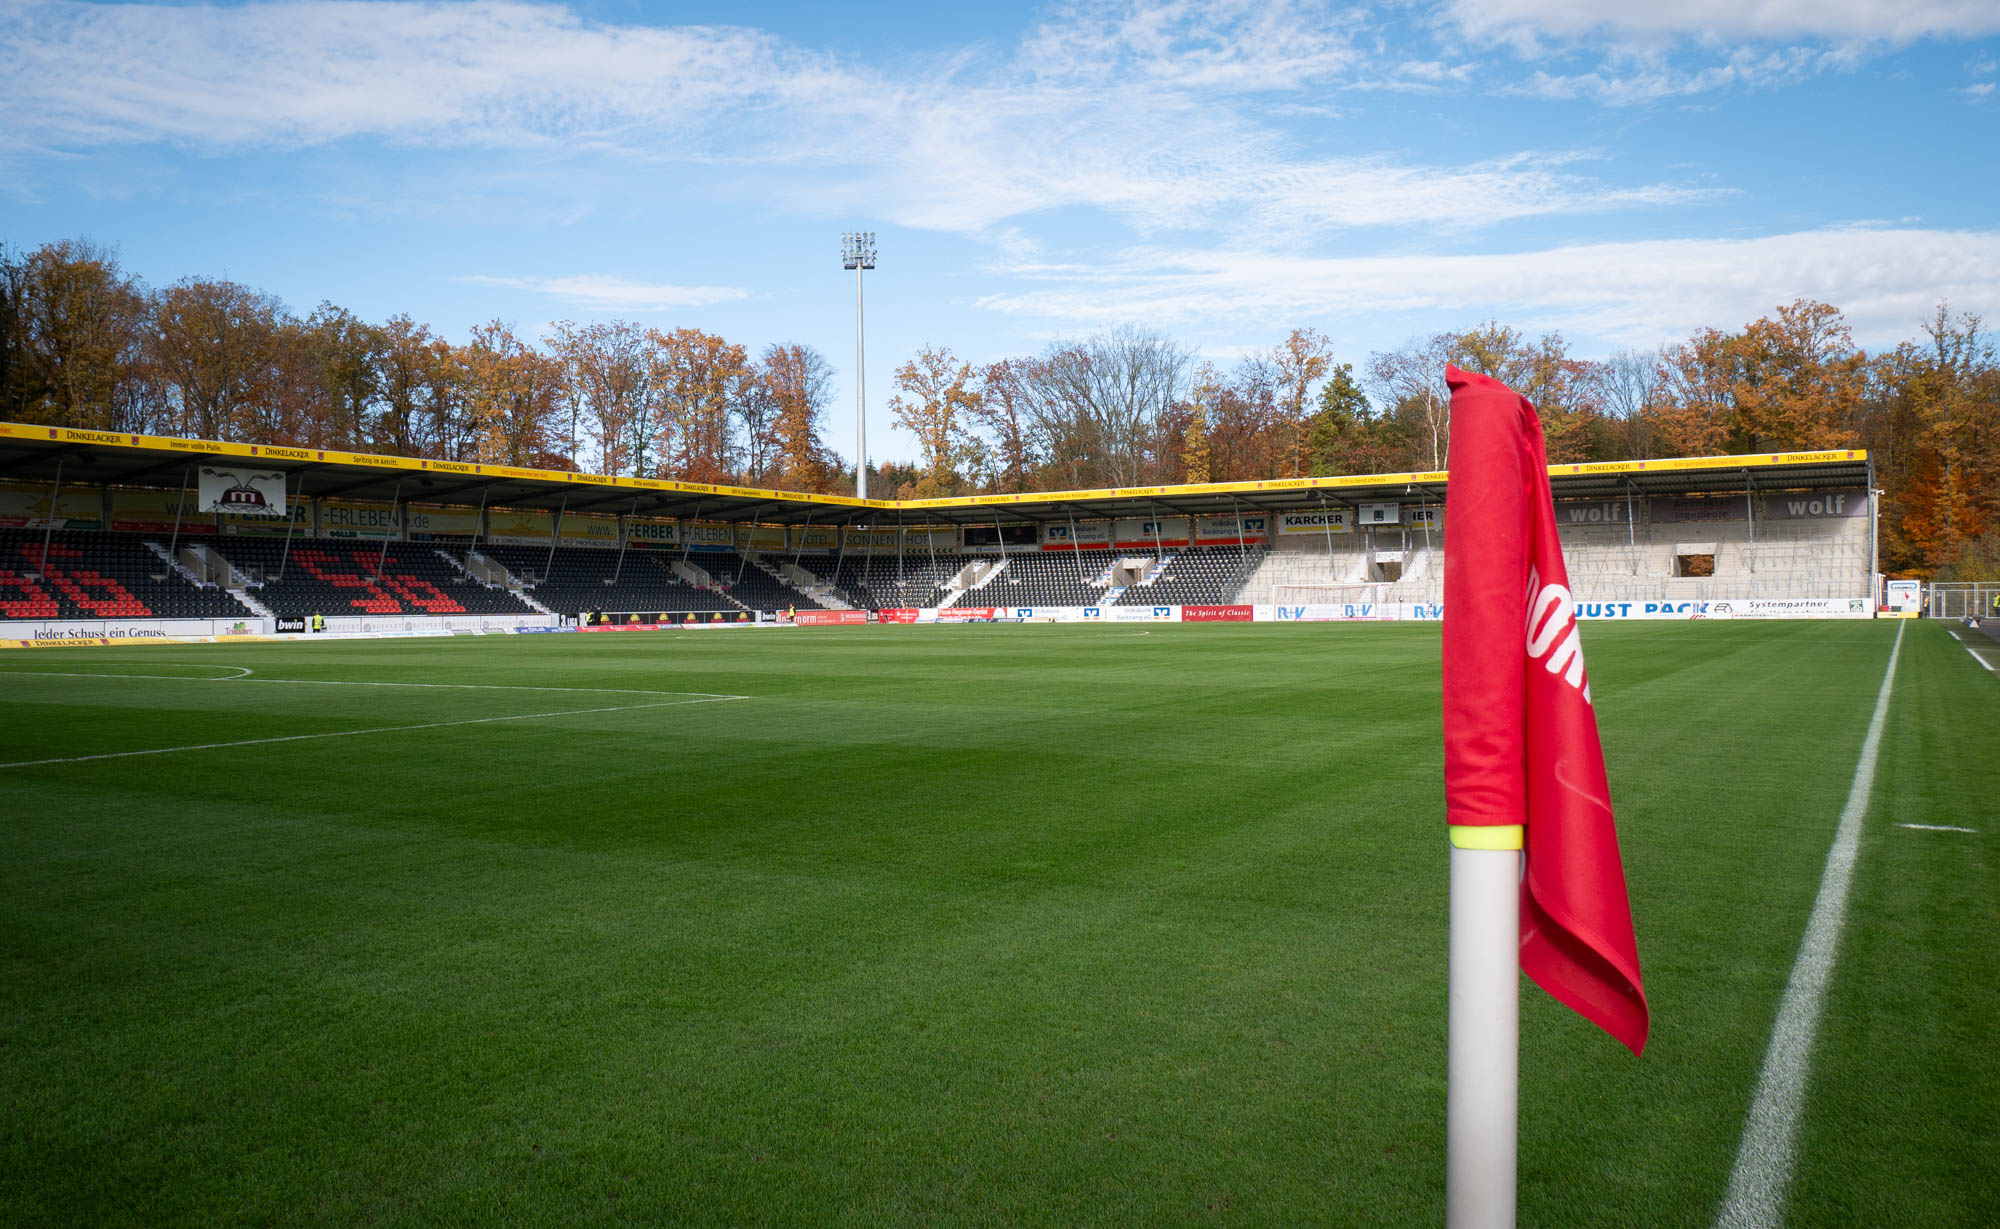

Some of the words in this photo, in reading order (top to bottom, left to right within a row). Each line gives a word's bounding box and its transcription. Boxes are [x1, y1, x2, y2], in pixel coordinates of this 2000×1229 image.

[67, 430, 122, 443] DINKELACKER
[170, 441, 189, 449] Immer
[190, 443, 205, 451] volle
[265, 447, 309, 458] DINKELACKER
[1786, 453, 1838, 461] DINKELACKER
[353, 456, 373, 465] Spritzig
[433, 461, 469, 472] DINKELACKER
[576, 474, 607, 484] DINKELACKER
[1786, 494, 1846, 515] wolf
[1568, 503, 1621, 522] wolf
[628, 524, 674, 538] FERBER
[846, 534, 895, 545] SONNEN
[1575, 603, 1632, 617] JUST
[1749, 601, 1828, 609] Systempartner
[1198, 610, 1217, 618] Spirit
[1218, 609, 1226, 618] of
[277, 618, 304, 630] bwin
[68, 627, 105, 639] Schuss
[109, 627, 125, 638] ein
[129, 626, 168, 638] Genuss
